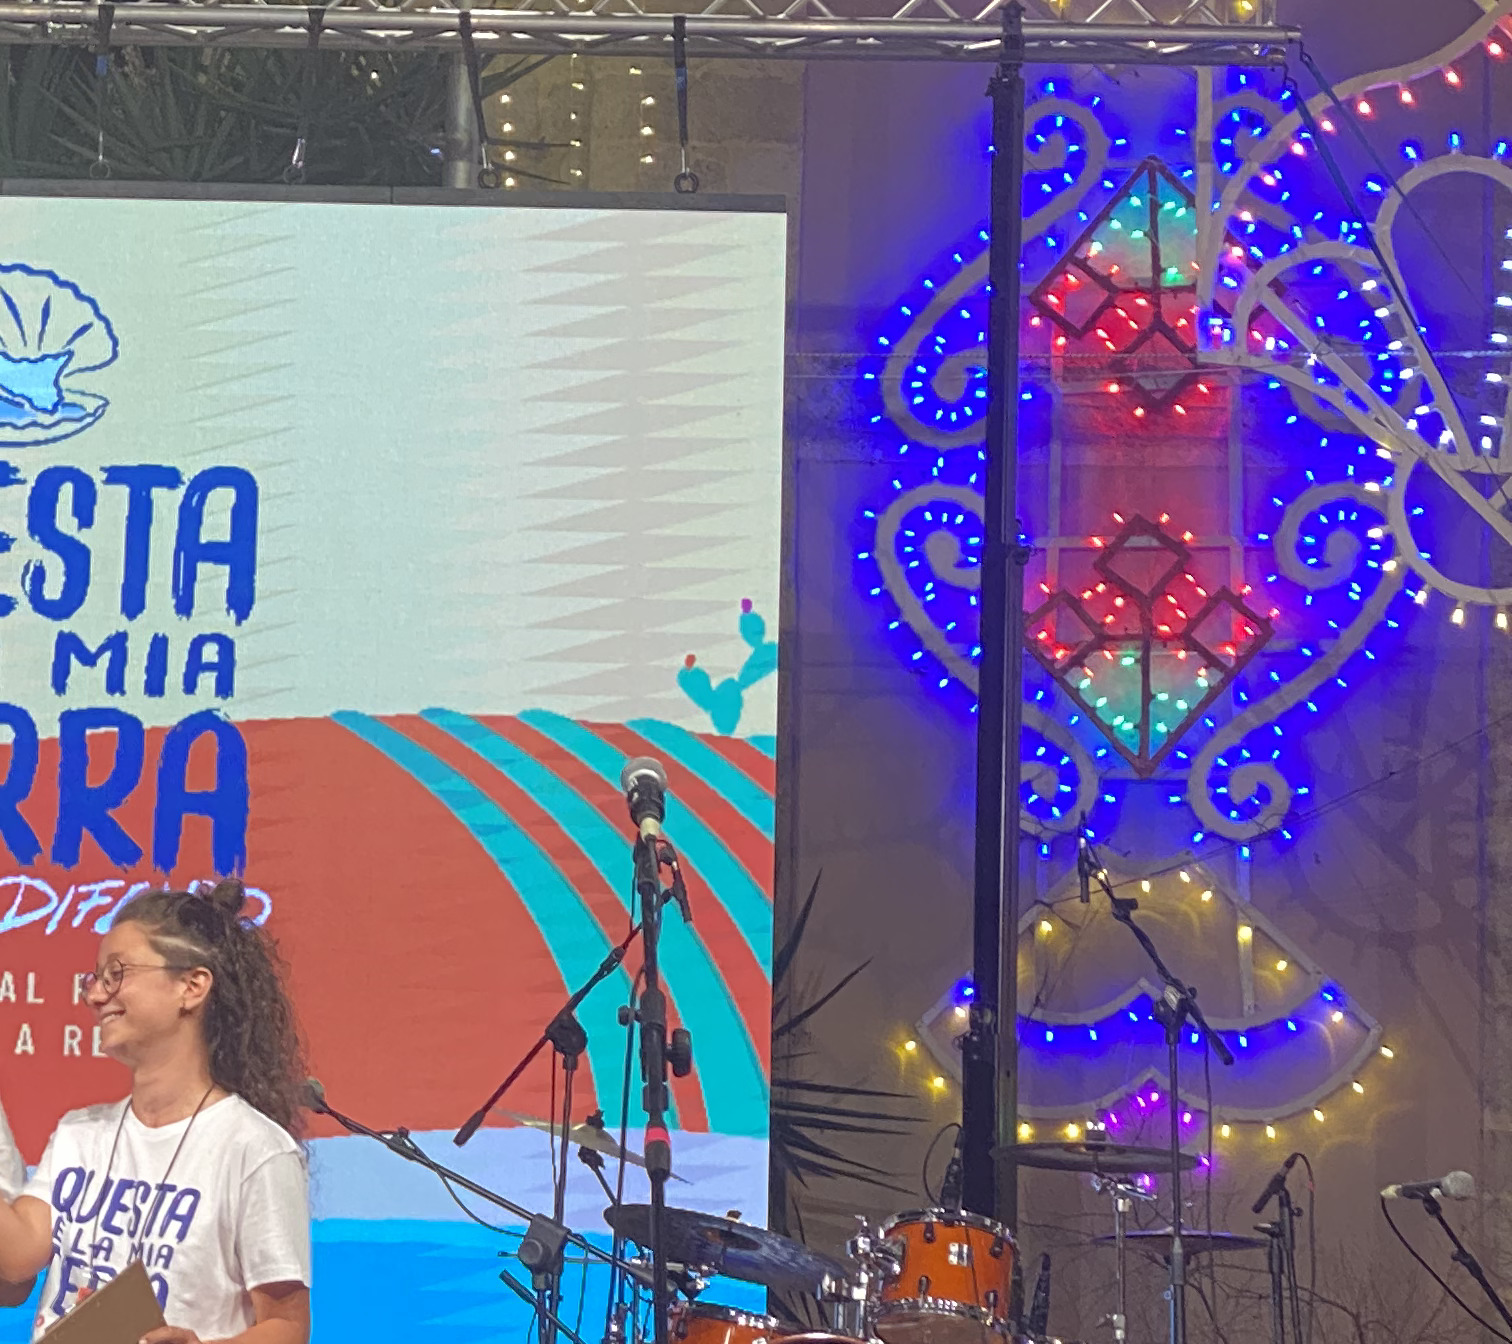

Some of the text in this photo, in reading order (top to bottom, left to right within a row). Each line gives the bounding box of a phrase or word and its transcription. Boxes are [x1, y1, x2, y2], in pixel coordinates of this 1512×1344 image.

[51, 629, 237, 697] MIA
[14, 1022, 35, 1055] A
[51, 1166, 201, 1245] QUESTA
[71, 1227, 114, 1262] LA
[127, 1242, 175, 1270] MIA
